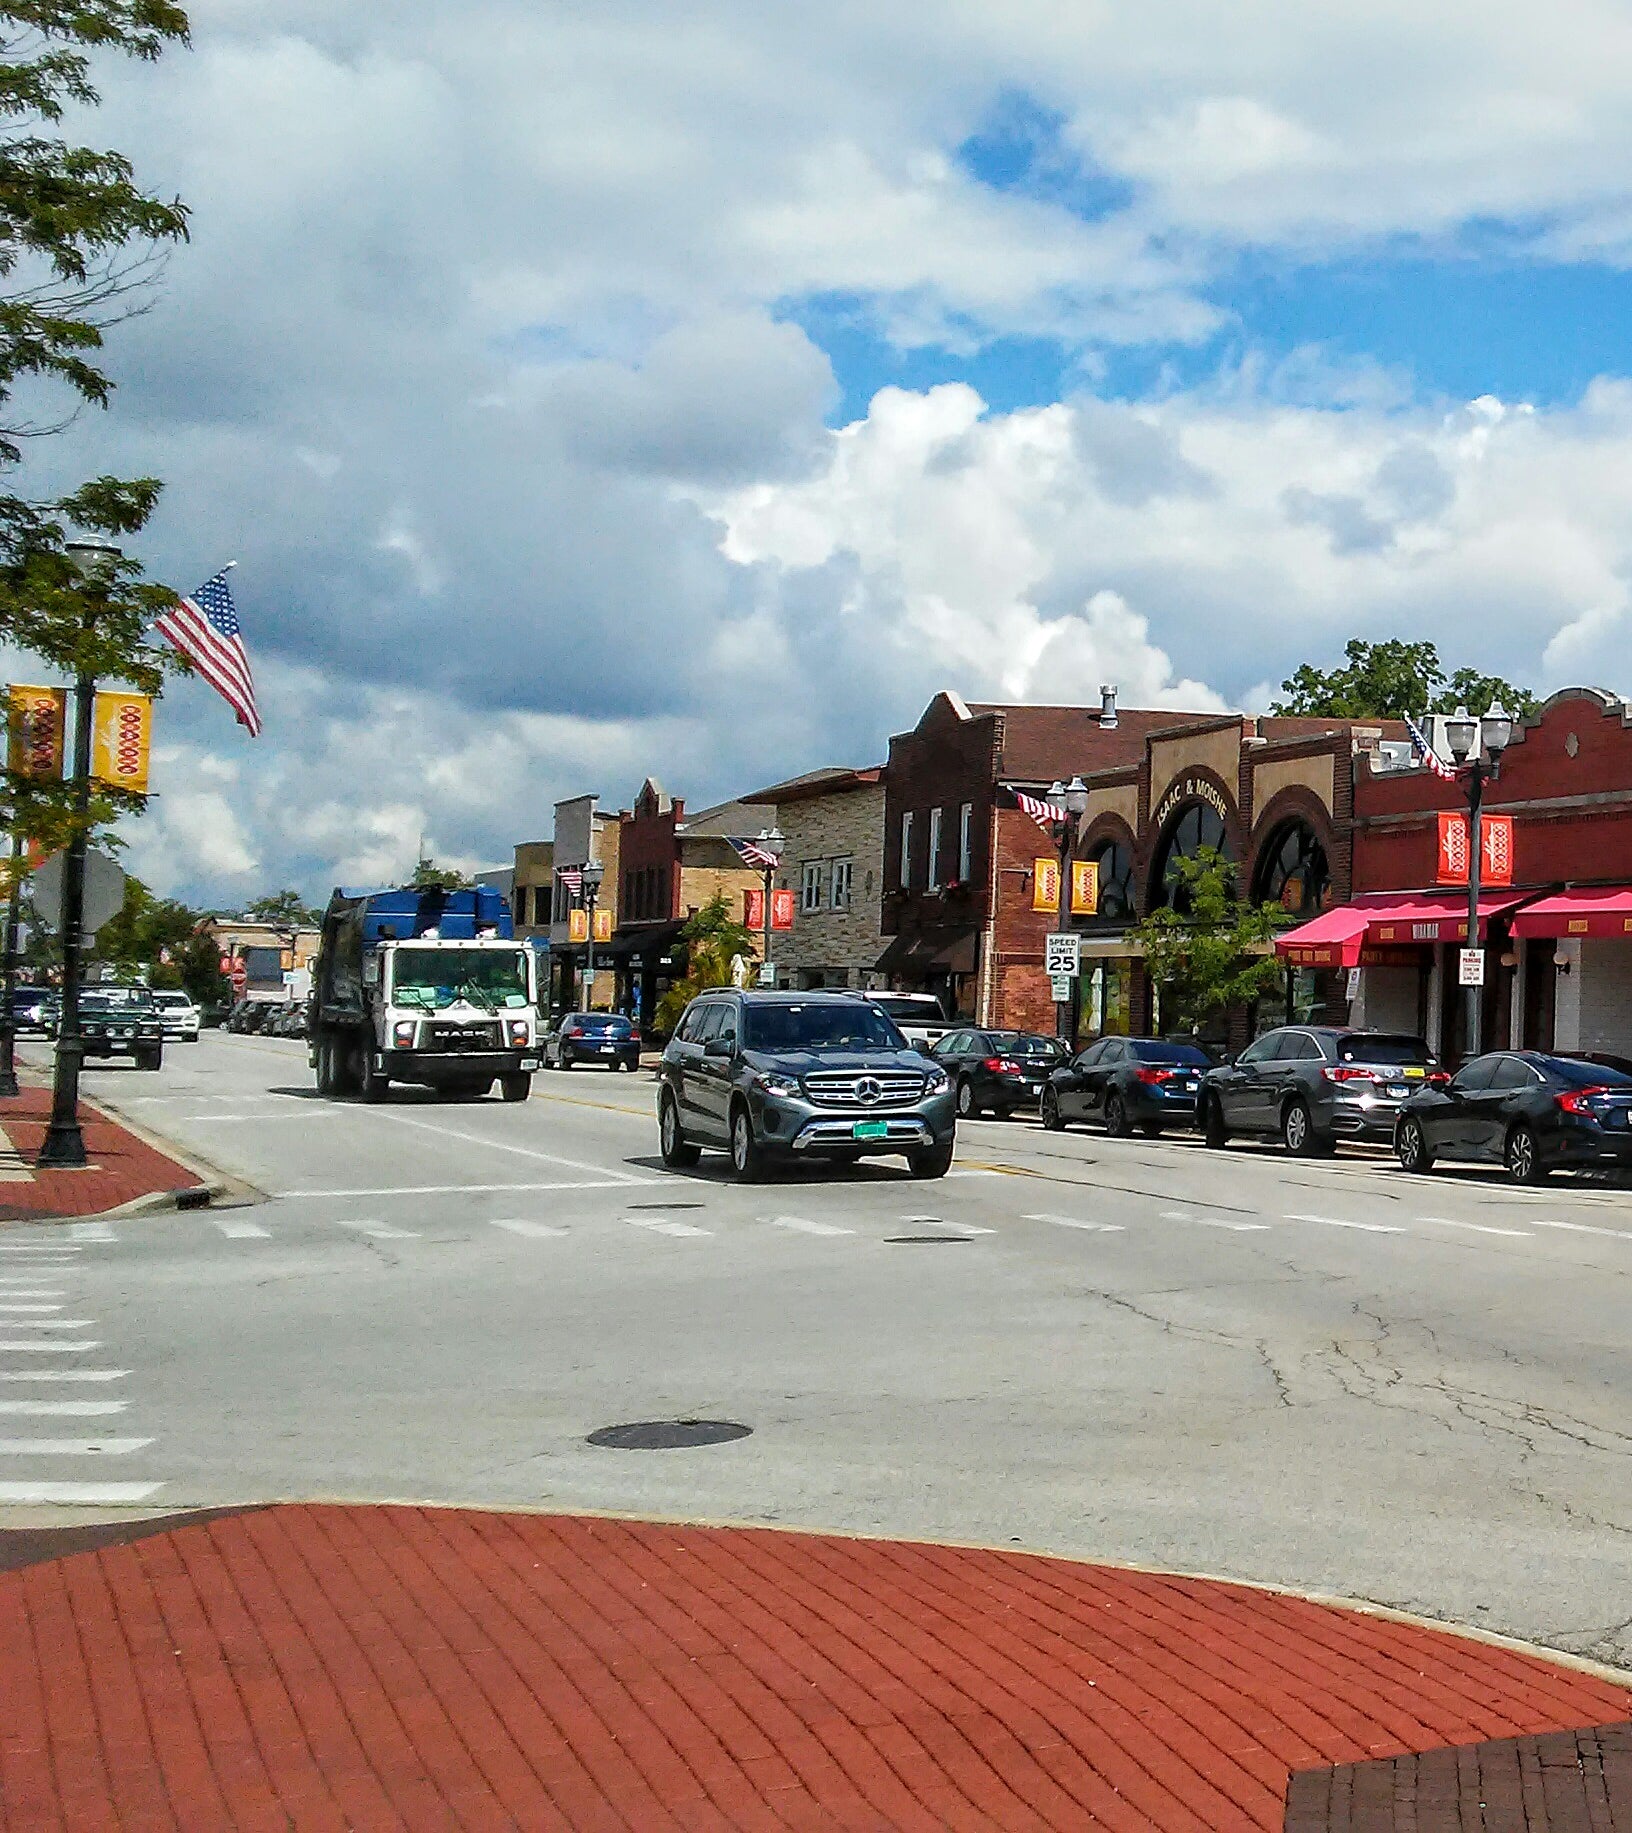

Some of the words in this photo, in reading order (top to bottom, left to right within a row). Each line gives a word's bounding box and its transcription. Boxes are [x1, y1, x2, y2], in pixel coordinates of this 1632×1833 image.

[1157, 784, 1181, 828] ISAAC
[1186, 779, 1194, 795] &
[1196, 778, 1228, 821] MOISHE
[1049, 956, 1075, 972] 25
